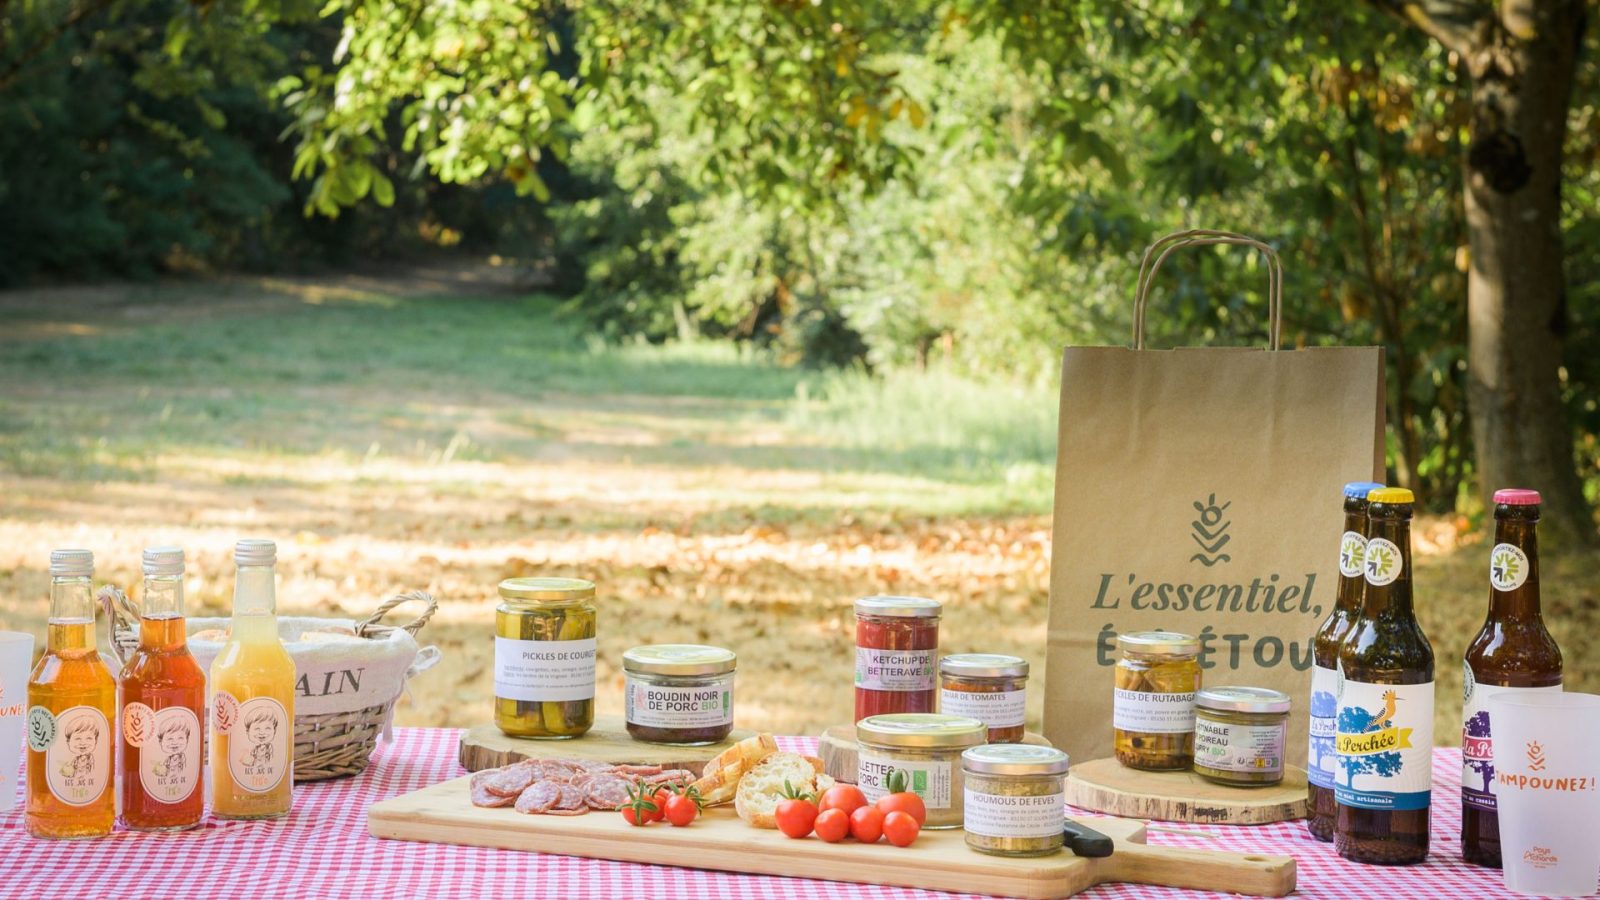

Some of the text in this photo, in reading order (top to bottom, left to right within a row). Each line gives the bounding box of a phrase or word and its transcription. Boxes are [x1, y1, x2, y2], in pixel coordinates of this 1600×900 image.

[1090, 573, 1322, 618] L'essentiel,
[522, 651, 555, 661] PICKLES
[558, 652, 568, 660] DE
[873, 656, 917, 664] KETCHUP
[868, 667, 922, 676] BETTERAVE
[295, 668, 365, 697] AIN
[648, 691, 718, 701] BOUDIN NOIR
[649, 701, 718, 711] DE PORC BIO
[1343, 733, 1396, 753] Perchée
[974, 794, 1017, 805] HOUMOUS
[1033, 796, 1055, 805] FEVES
